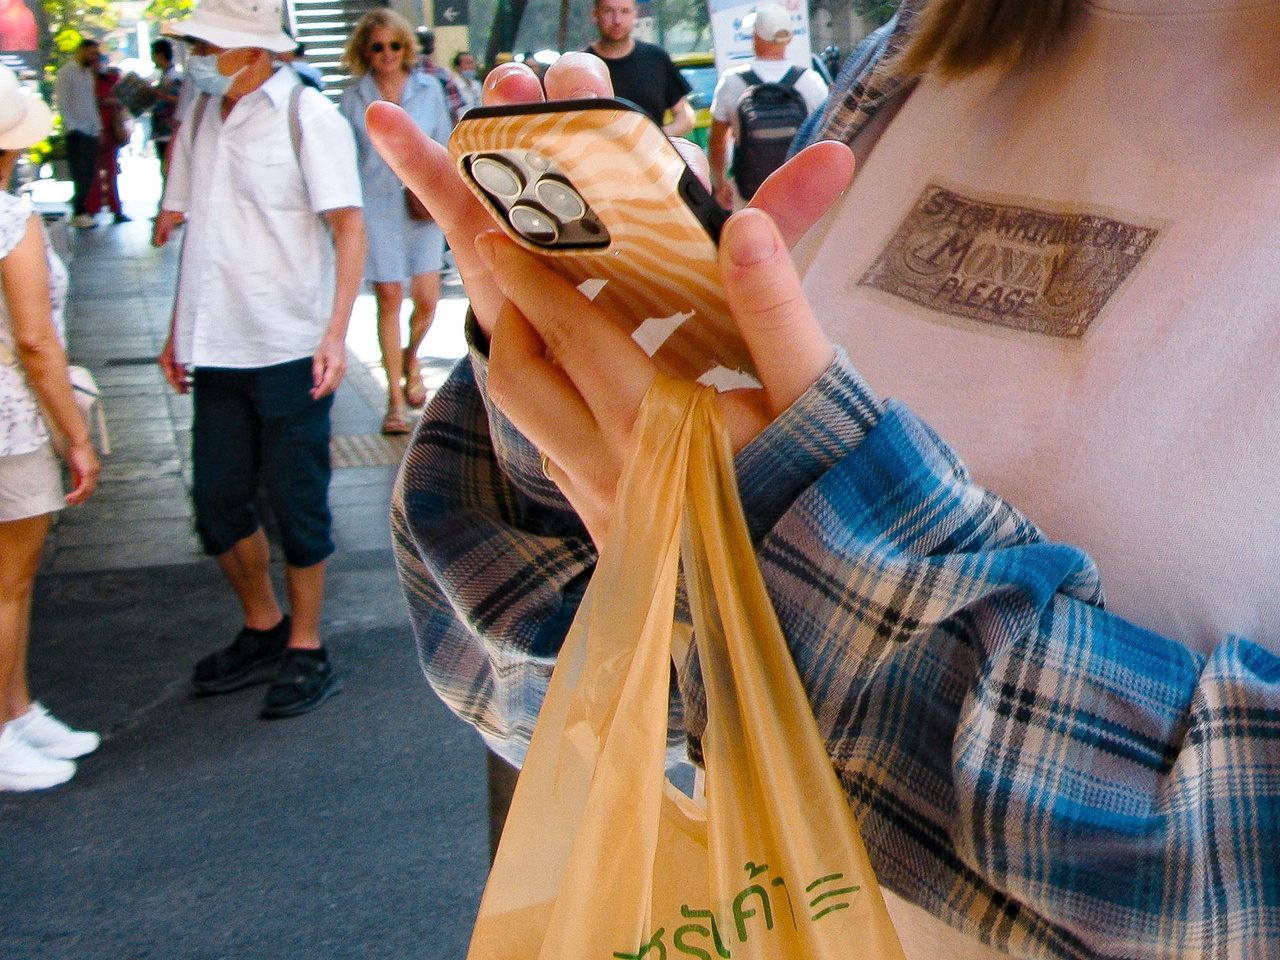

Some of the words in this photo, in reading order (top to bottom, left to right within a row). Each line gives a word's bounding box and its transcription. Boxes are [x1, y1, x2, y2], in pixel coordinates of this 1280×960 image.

[921, 189, 996, 231] STOP
[995, 209, 1091, 244] WRITING
[933, 276, 1038, 317] PLEASE
